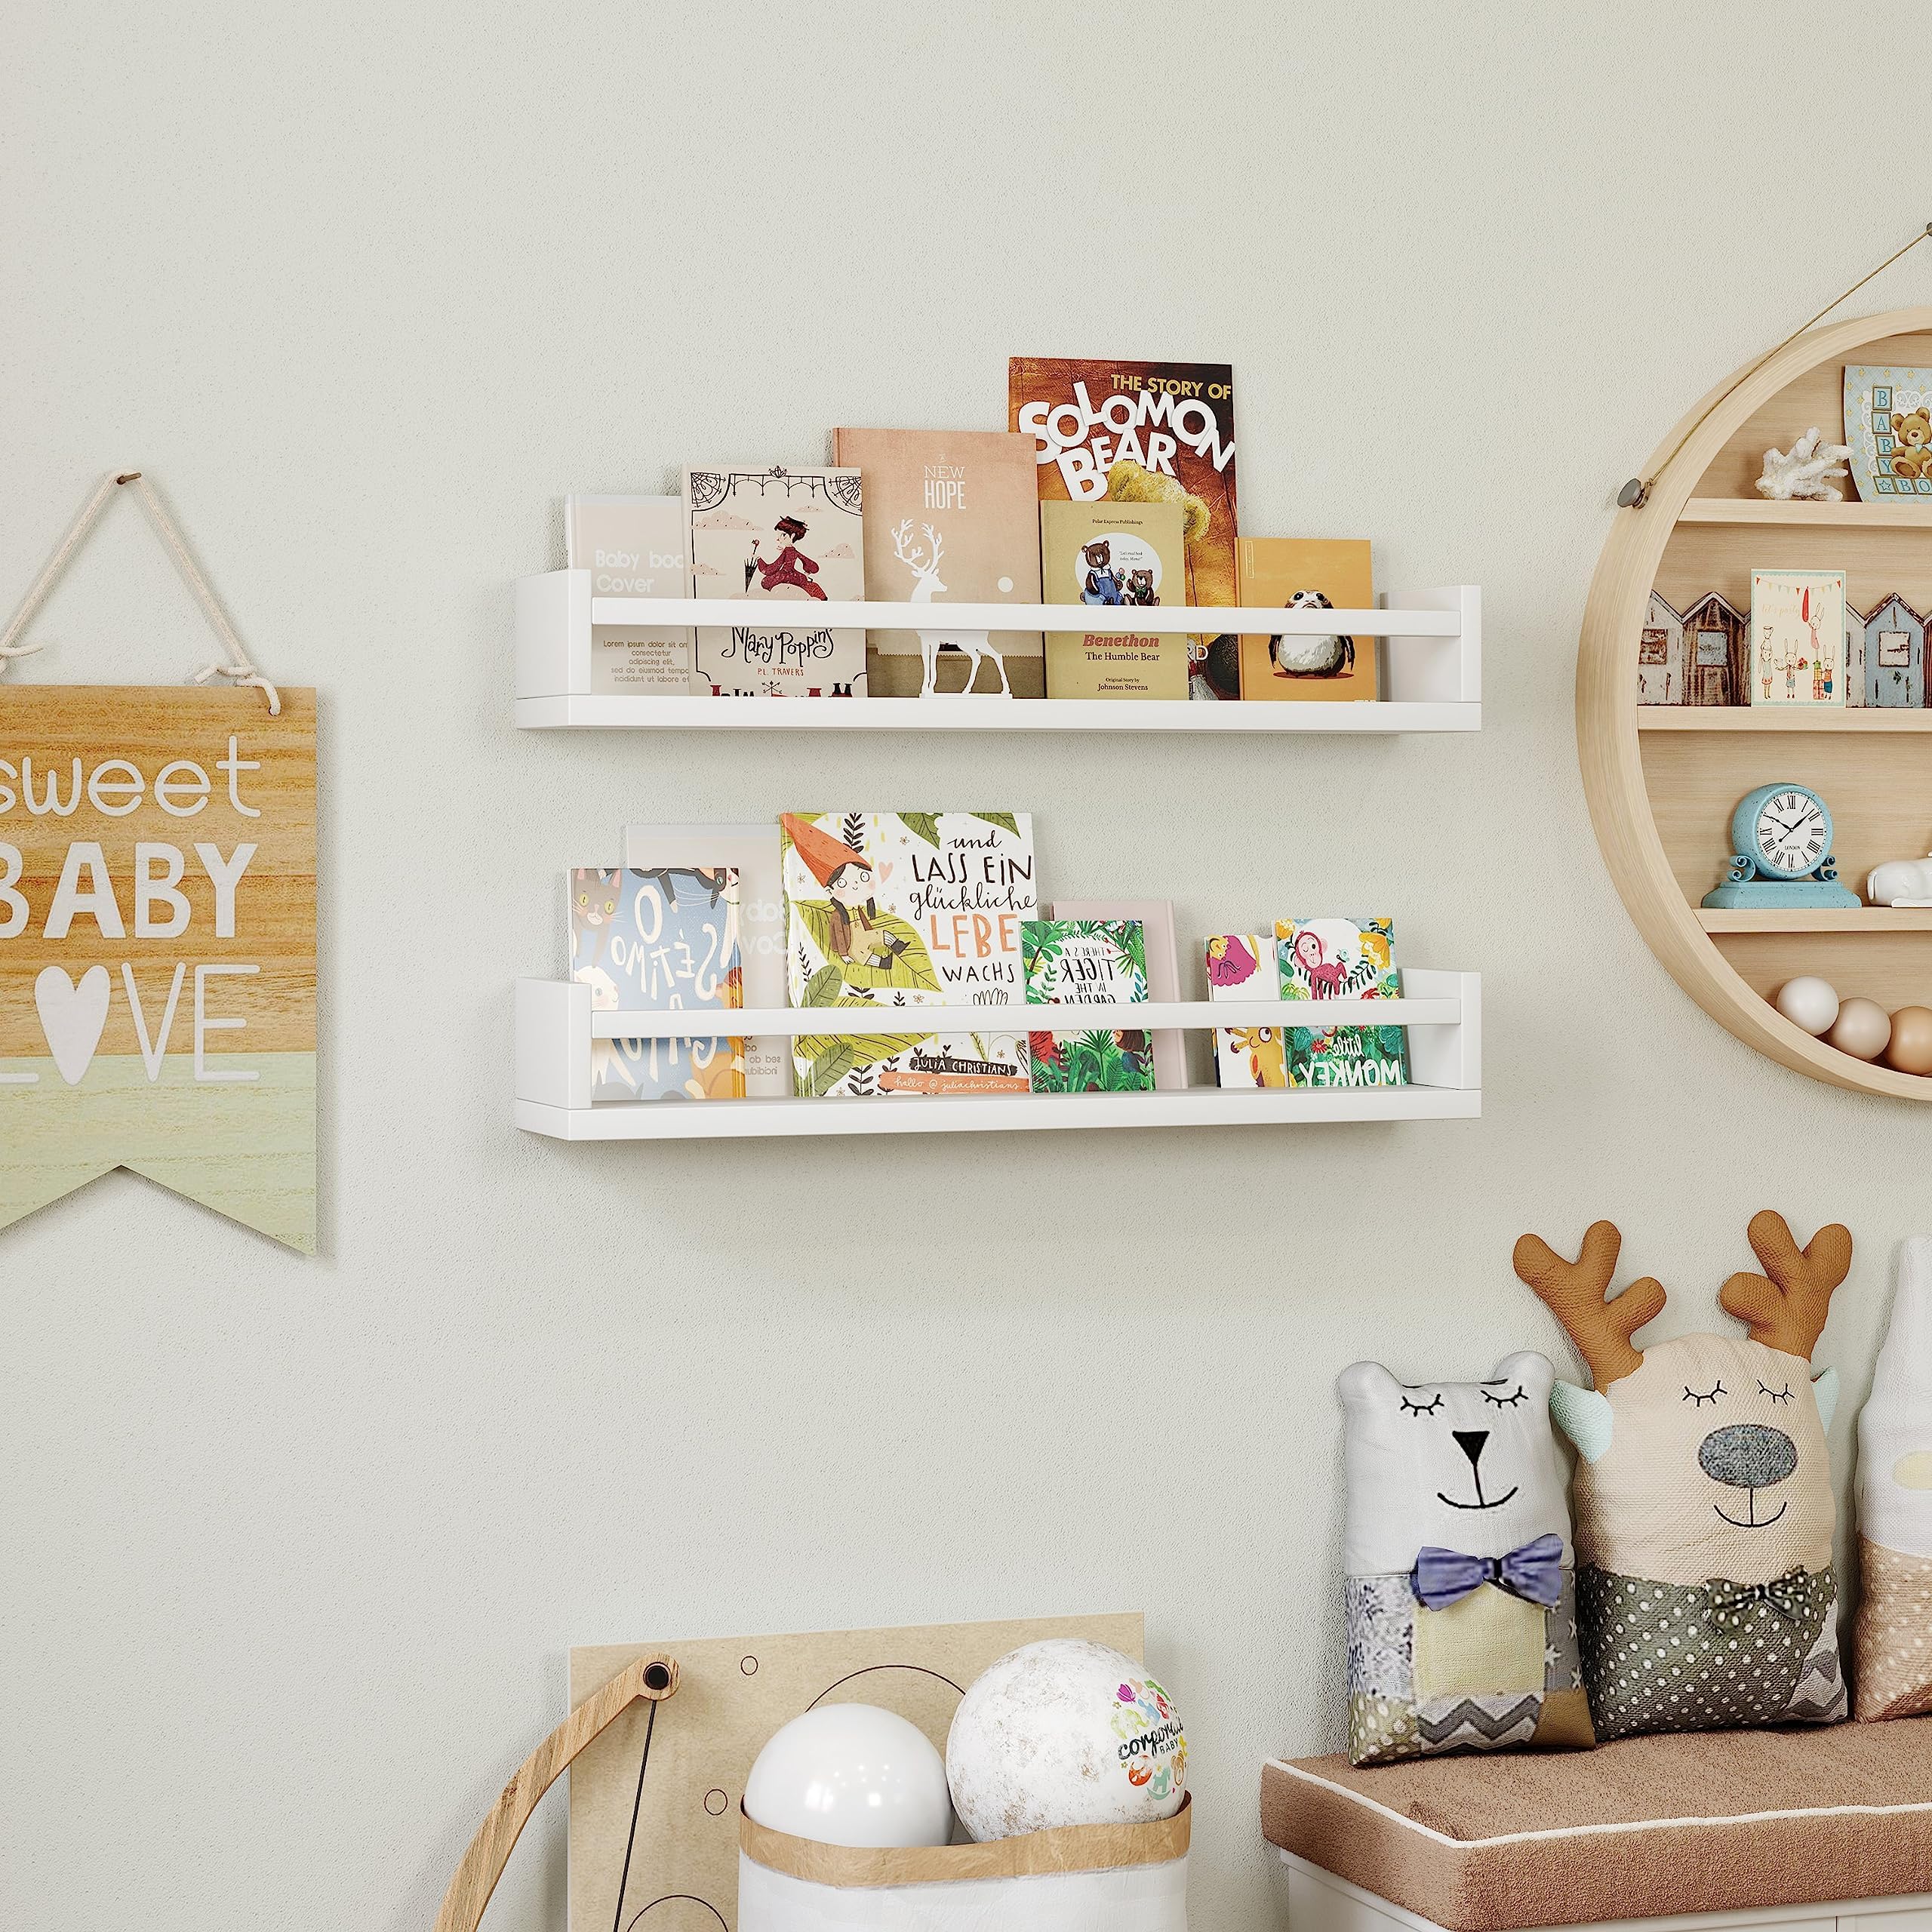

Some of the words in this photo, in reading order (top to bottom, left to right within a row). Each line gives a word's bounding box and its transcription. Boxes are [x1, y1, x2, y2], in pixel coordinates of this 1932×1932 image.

[1111, 374, 1142, 392] THE
[1148, 377, 1204, 397] STORY
[1208, 383, 1232, 400] OF
[1019, 381, 1235, 472] SOLOMON
[924, 465, 965, 478] NEW
[1057, 428, 1177, 502] BEAR
[924, 480, 967, 509] HOPE
[595, 549, 640, 571] Baby
[597, 574, 655, 592] Cover
[721, 627, 774, 663] Mary
[775, 628, 834, 667] Poppins
[1082, 634, 1160, 648] Benethon
[1085, 652, 1103, 660] The
[1105, 652, 1139, 661] Humble
[1141, 652, 1160, 661] Bear
[771, 668, 804, 676] TRAVERS
[1097, 683, 1124, 692] Johnson
[947, 830, 1002, 849] und
[912, 853, 968, 884] LASS
[909, 881, 1038, 921] glückliche
[931, 914, 1018, 958] LEBE
[942, 961, 1015, 983] WACHS
[1159, 1738, 1178, 1754] BABY
